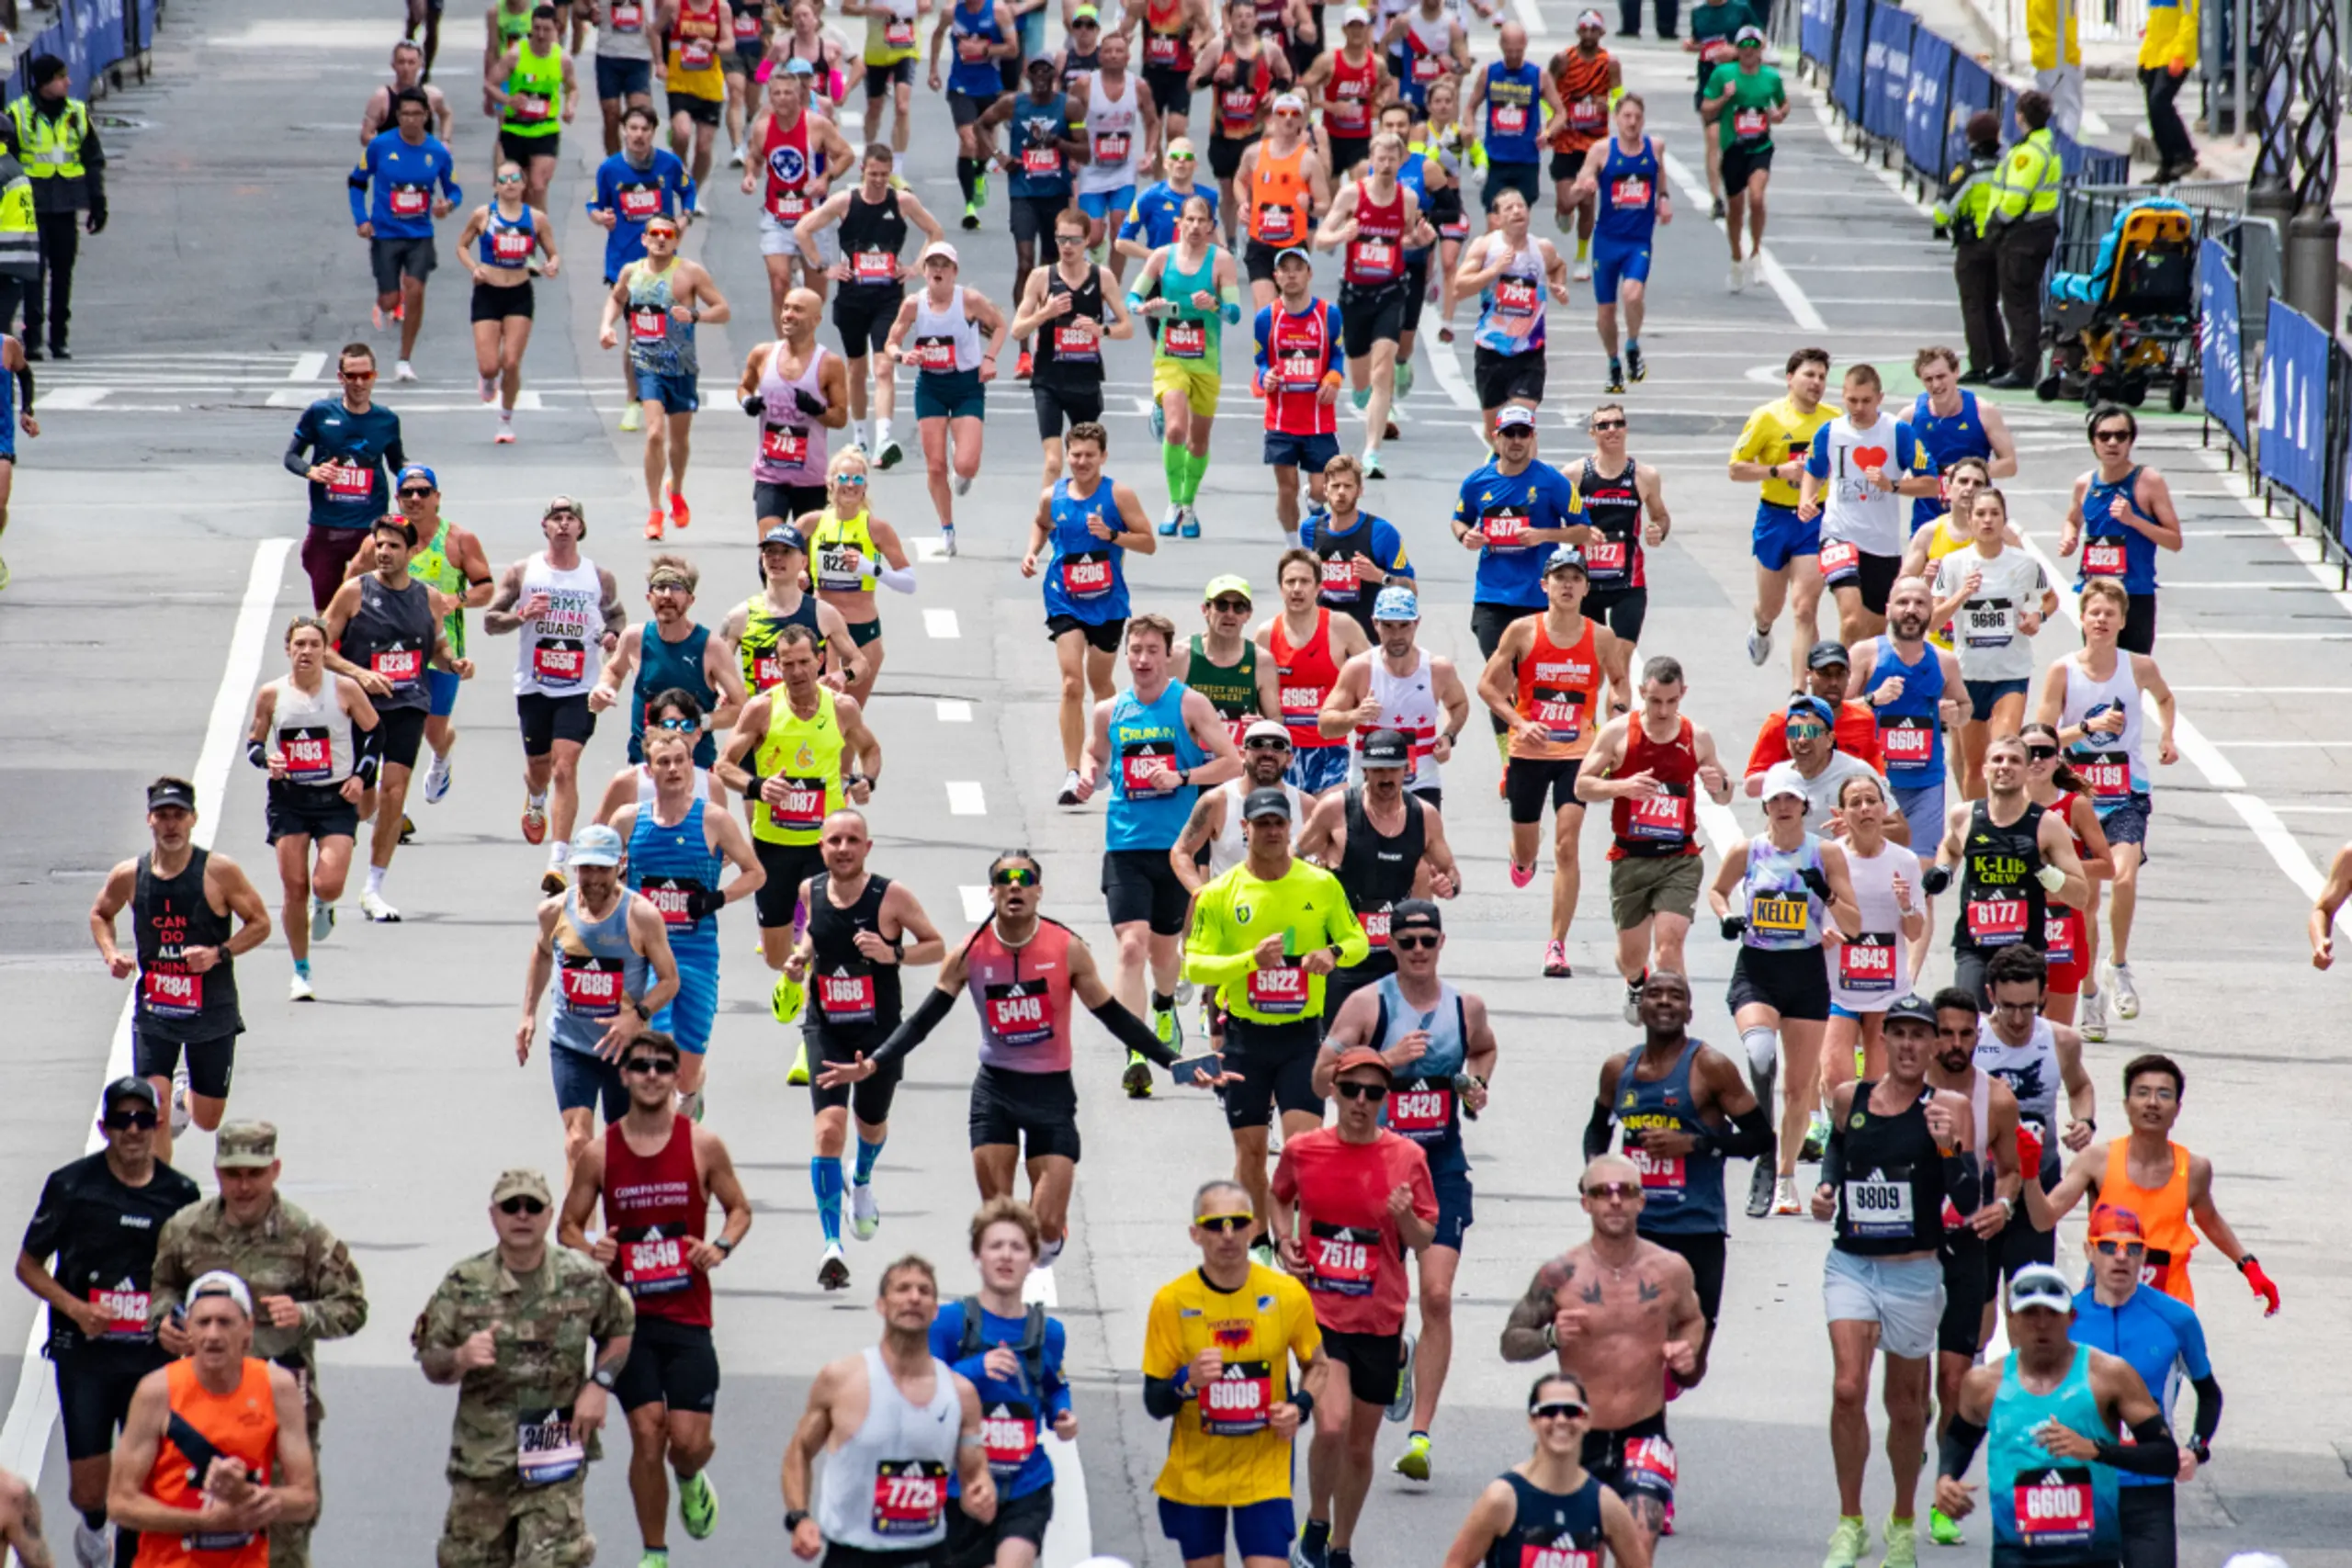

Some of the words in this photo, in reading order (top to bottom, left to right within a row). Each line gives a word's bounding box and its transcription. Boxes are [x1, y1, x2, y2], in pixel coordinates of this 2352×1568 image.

[1838, 445, 1847, 479] I
[550, 597, 587, 612] RMY
[536, 620, 583, 637] GUARD
[1973, 855, 2029, 874] K-LIB
[1980, 871, 2020, 885] CREW
[164, 899, 171, 912] I
[1756, 901, 1804, 924] KELLY
[153, 916, 187, 929] CAN
[161, 930, 185, 942] DO
[1621, 1113, 1681, 1131] ANGOLA
[2027, 1485, 2082, 1519] 6600
